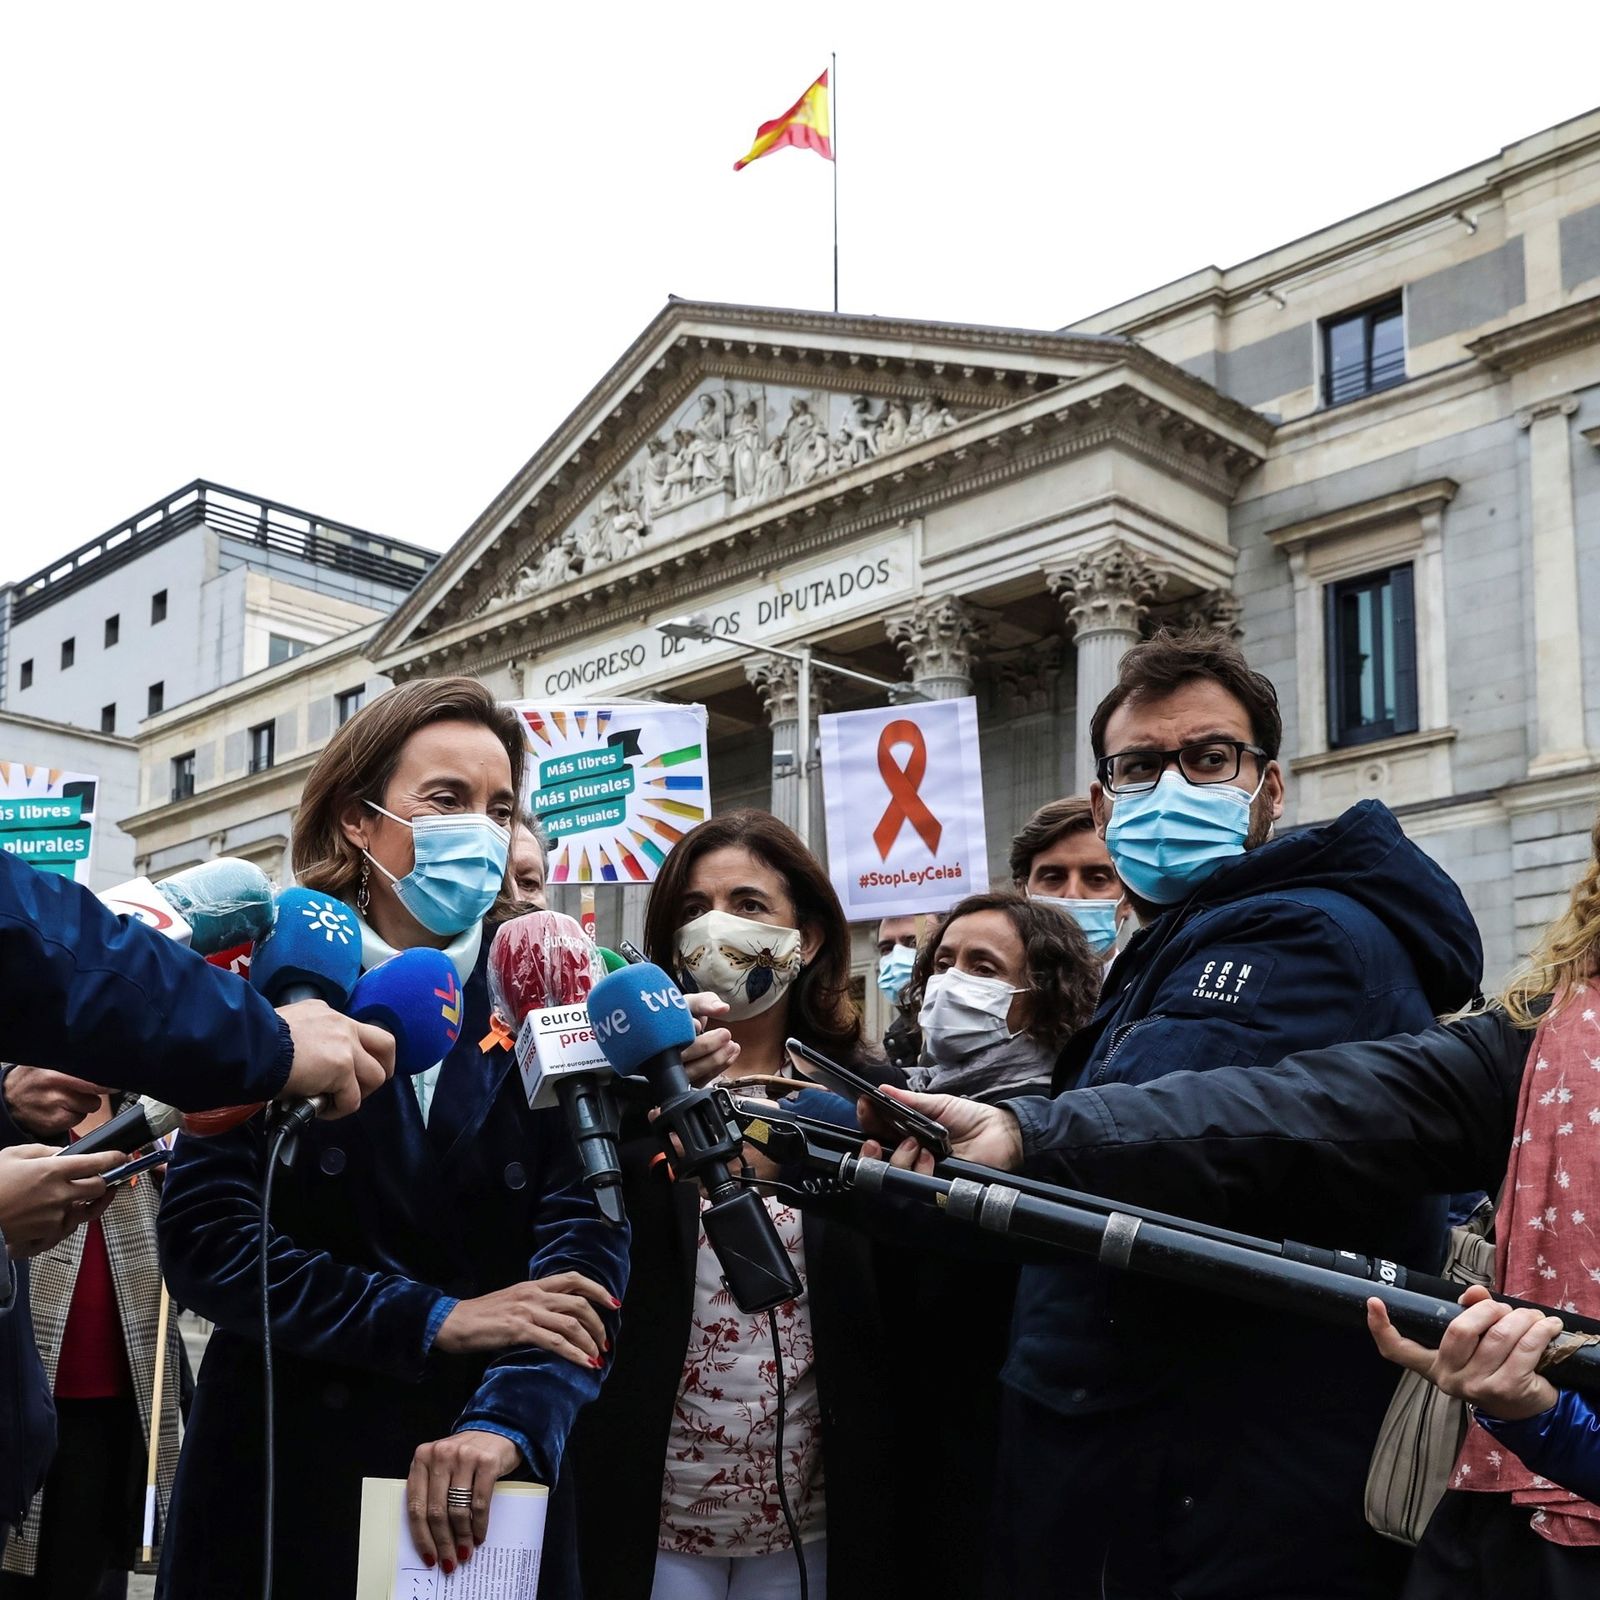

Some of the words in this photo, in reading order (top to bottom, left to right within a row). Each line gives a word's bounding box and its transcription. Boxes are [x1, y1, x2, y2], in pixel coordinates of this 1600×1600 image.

[545, 644, 646, 695] CONGRESO
[758, 559, 890, 625] DIPUTADOS
[546, 761, 575, 778] Más
[577, 753, 617, 770] libres
[535, 790, 566, 809] Más
[569, 777, 631, 802] plurales
[19, 805, 71, 819] libres
[547, 817, 573, 833] Más
[575, 808, 620, 827] iguales
[3, 836, 85, 854] plurales
[858, 861, 962, 889] #StopLeyCelaá
[639, 986, 688, 1013] tve
[1192, 988, 1240, 1004] COMPANY
[560, 1030, 597, 1048] pres
